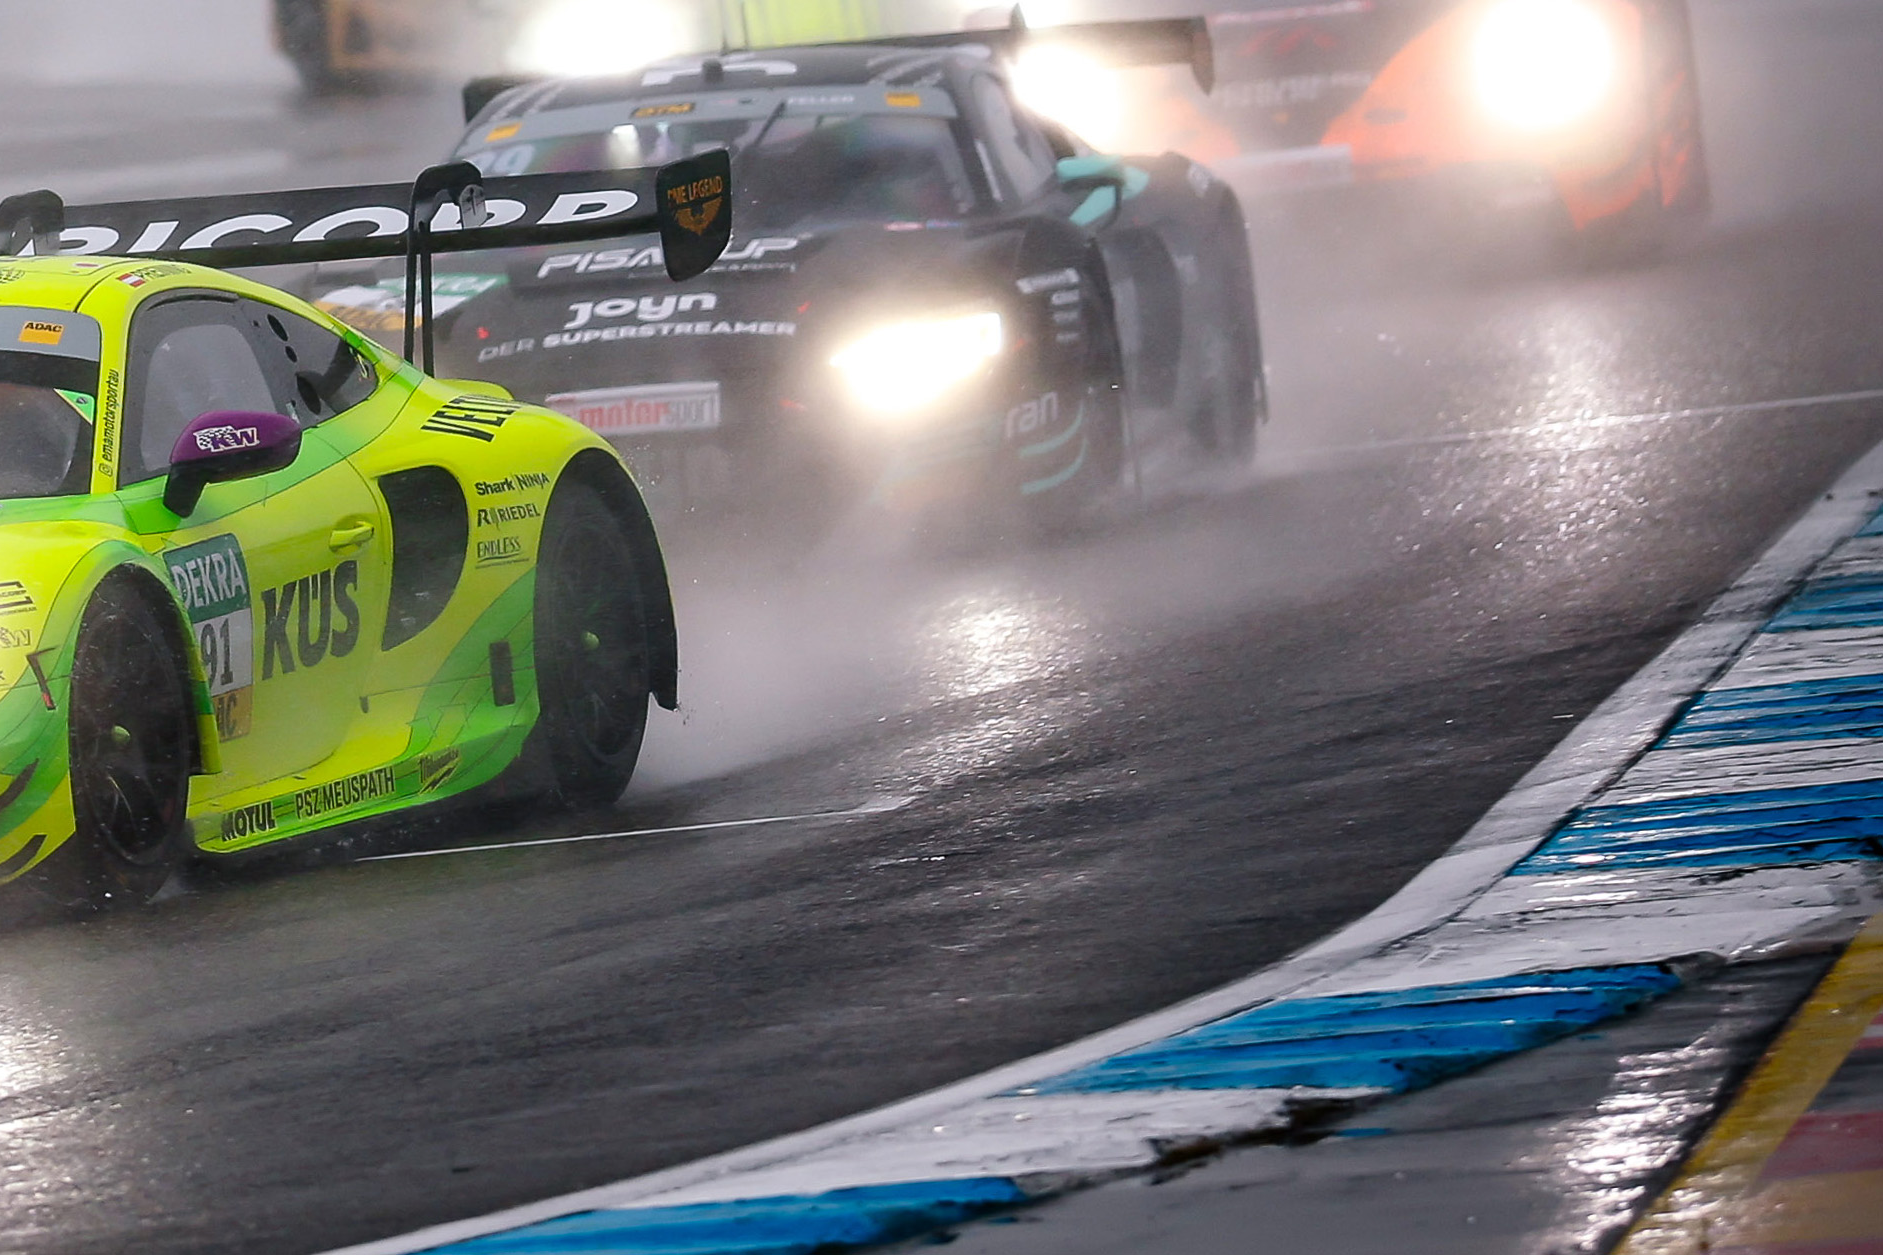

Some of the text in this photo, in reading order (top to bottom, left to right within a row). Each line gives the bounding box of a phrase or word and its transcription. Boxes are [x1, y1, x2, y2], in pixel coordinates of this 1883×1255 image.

[24, 321, 62, 333] ADAC
[478, 321, 797, 364] DER SUPERSTREAMER
[101, 369, 119, 462] emamotorsportau
[498, 503, 540, 522] RIEDEL
[477, 537, 521, 558] ENDLESS
[171, 548, 246, 611] DEKRA
[261, 559, 360, 682] KÜS
[222, 767, 395, 842] MOTUL PSZ MEUSPATH
